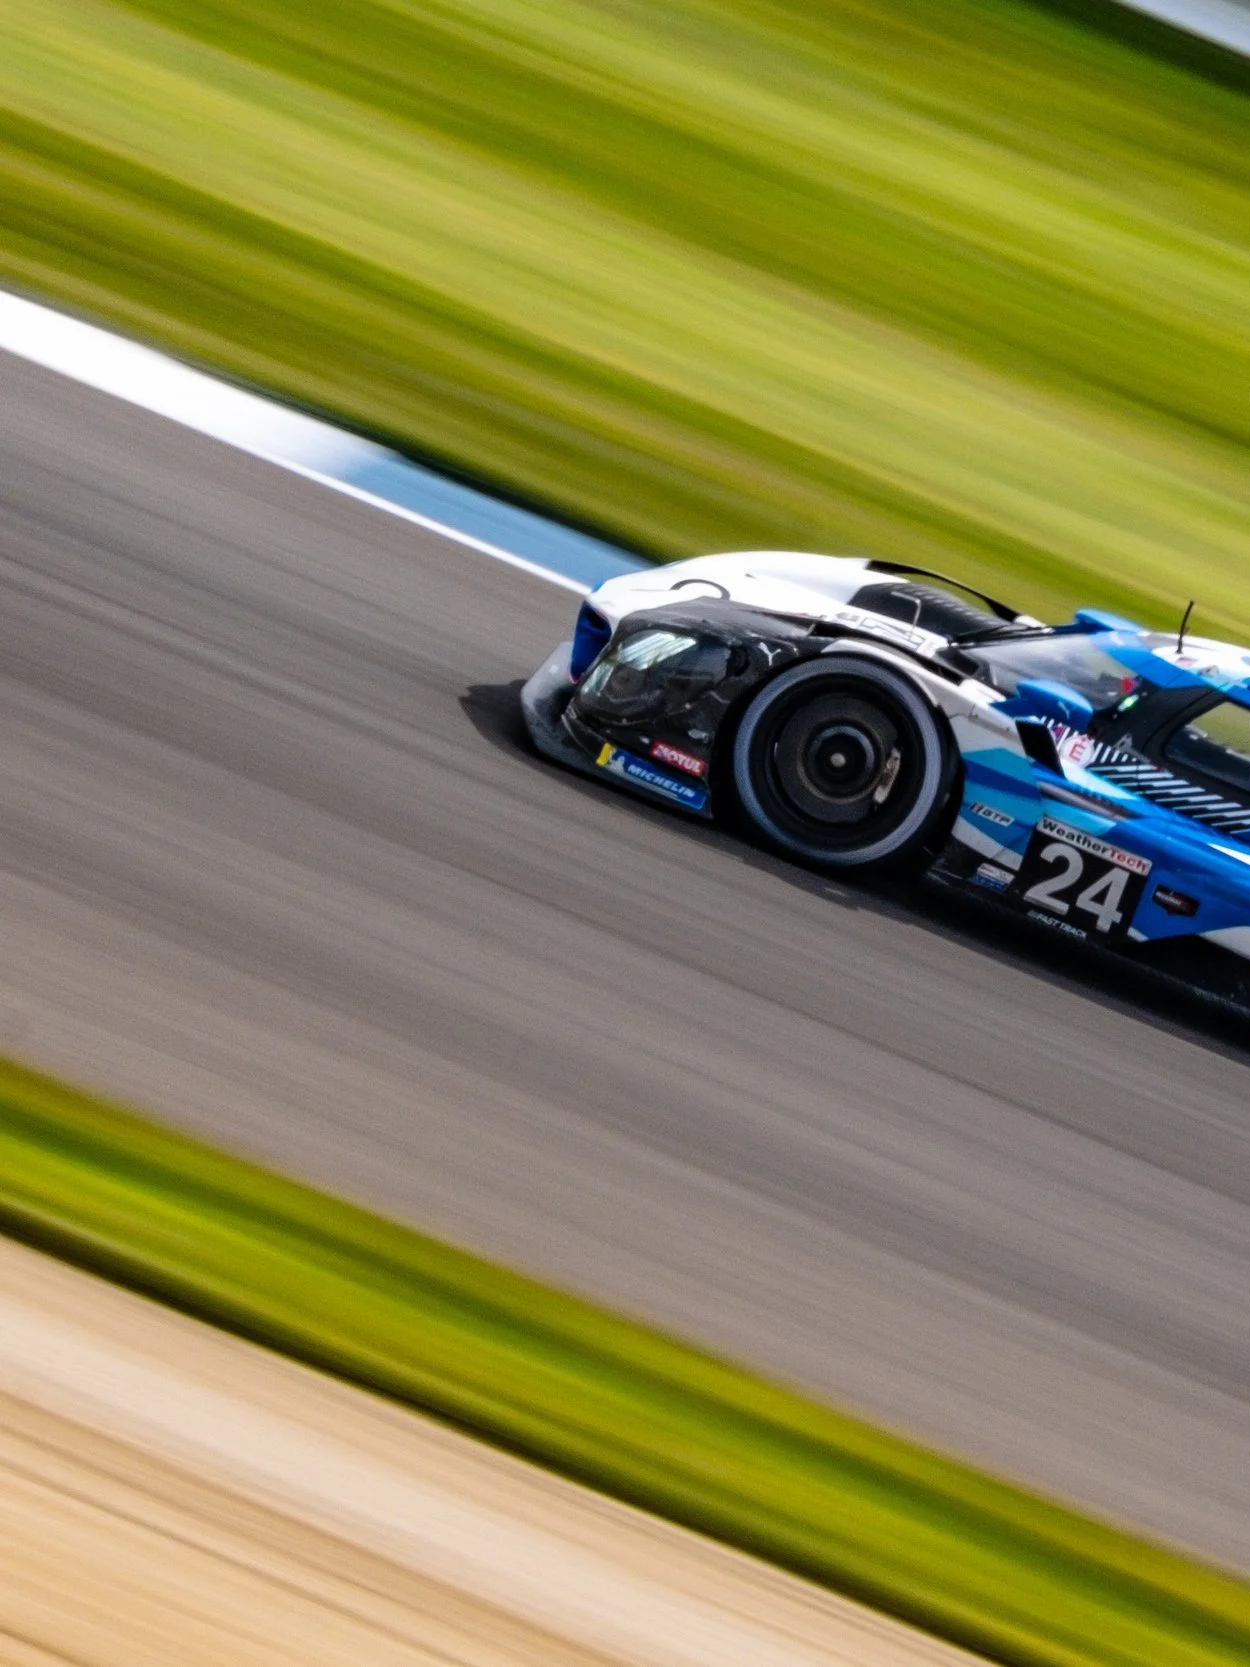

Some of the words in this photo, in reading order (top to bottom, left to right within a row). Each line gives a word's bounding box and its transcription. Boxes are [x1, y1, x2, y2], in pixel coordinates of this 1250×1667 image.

[627, 764, 696, 798] MICHELIN
[653, 745, 702, 774] MOTUL
[1042, 818, 1149, 873] WeatherTech
[1023, 842, 1131, 933] 24
